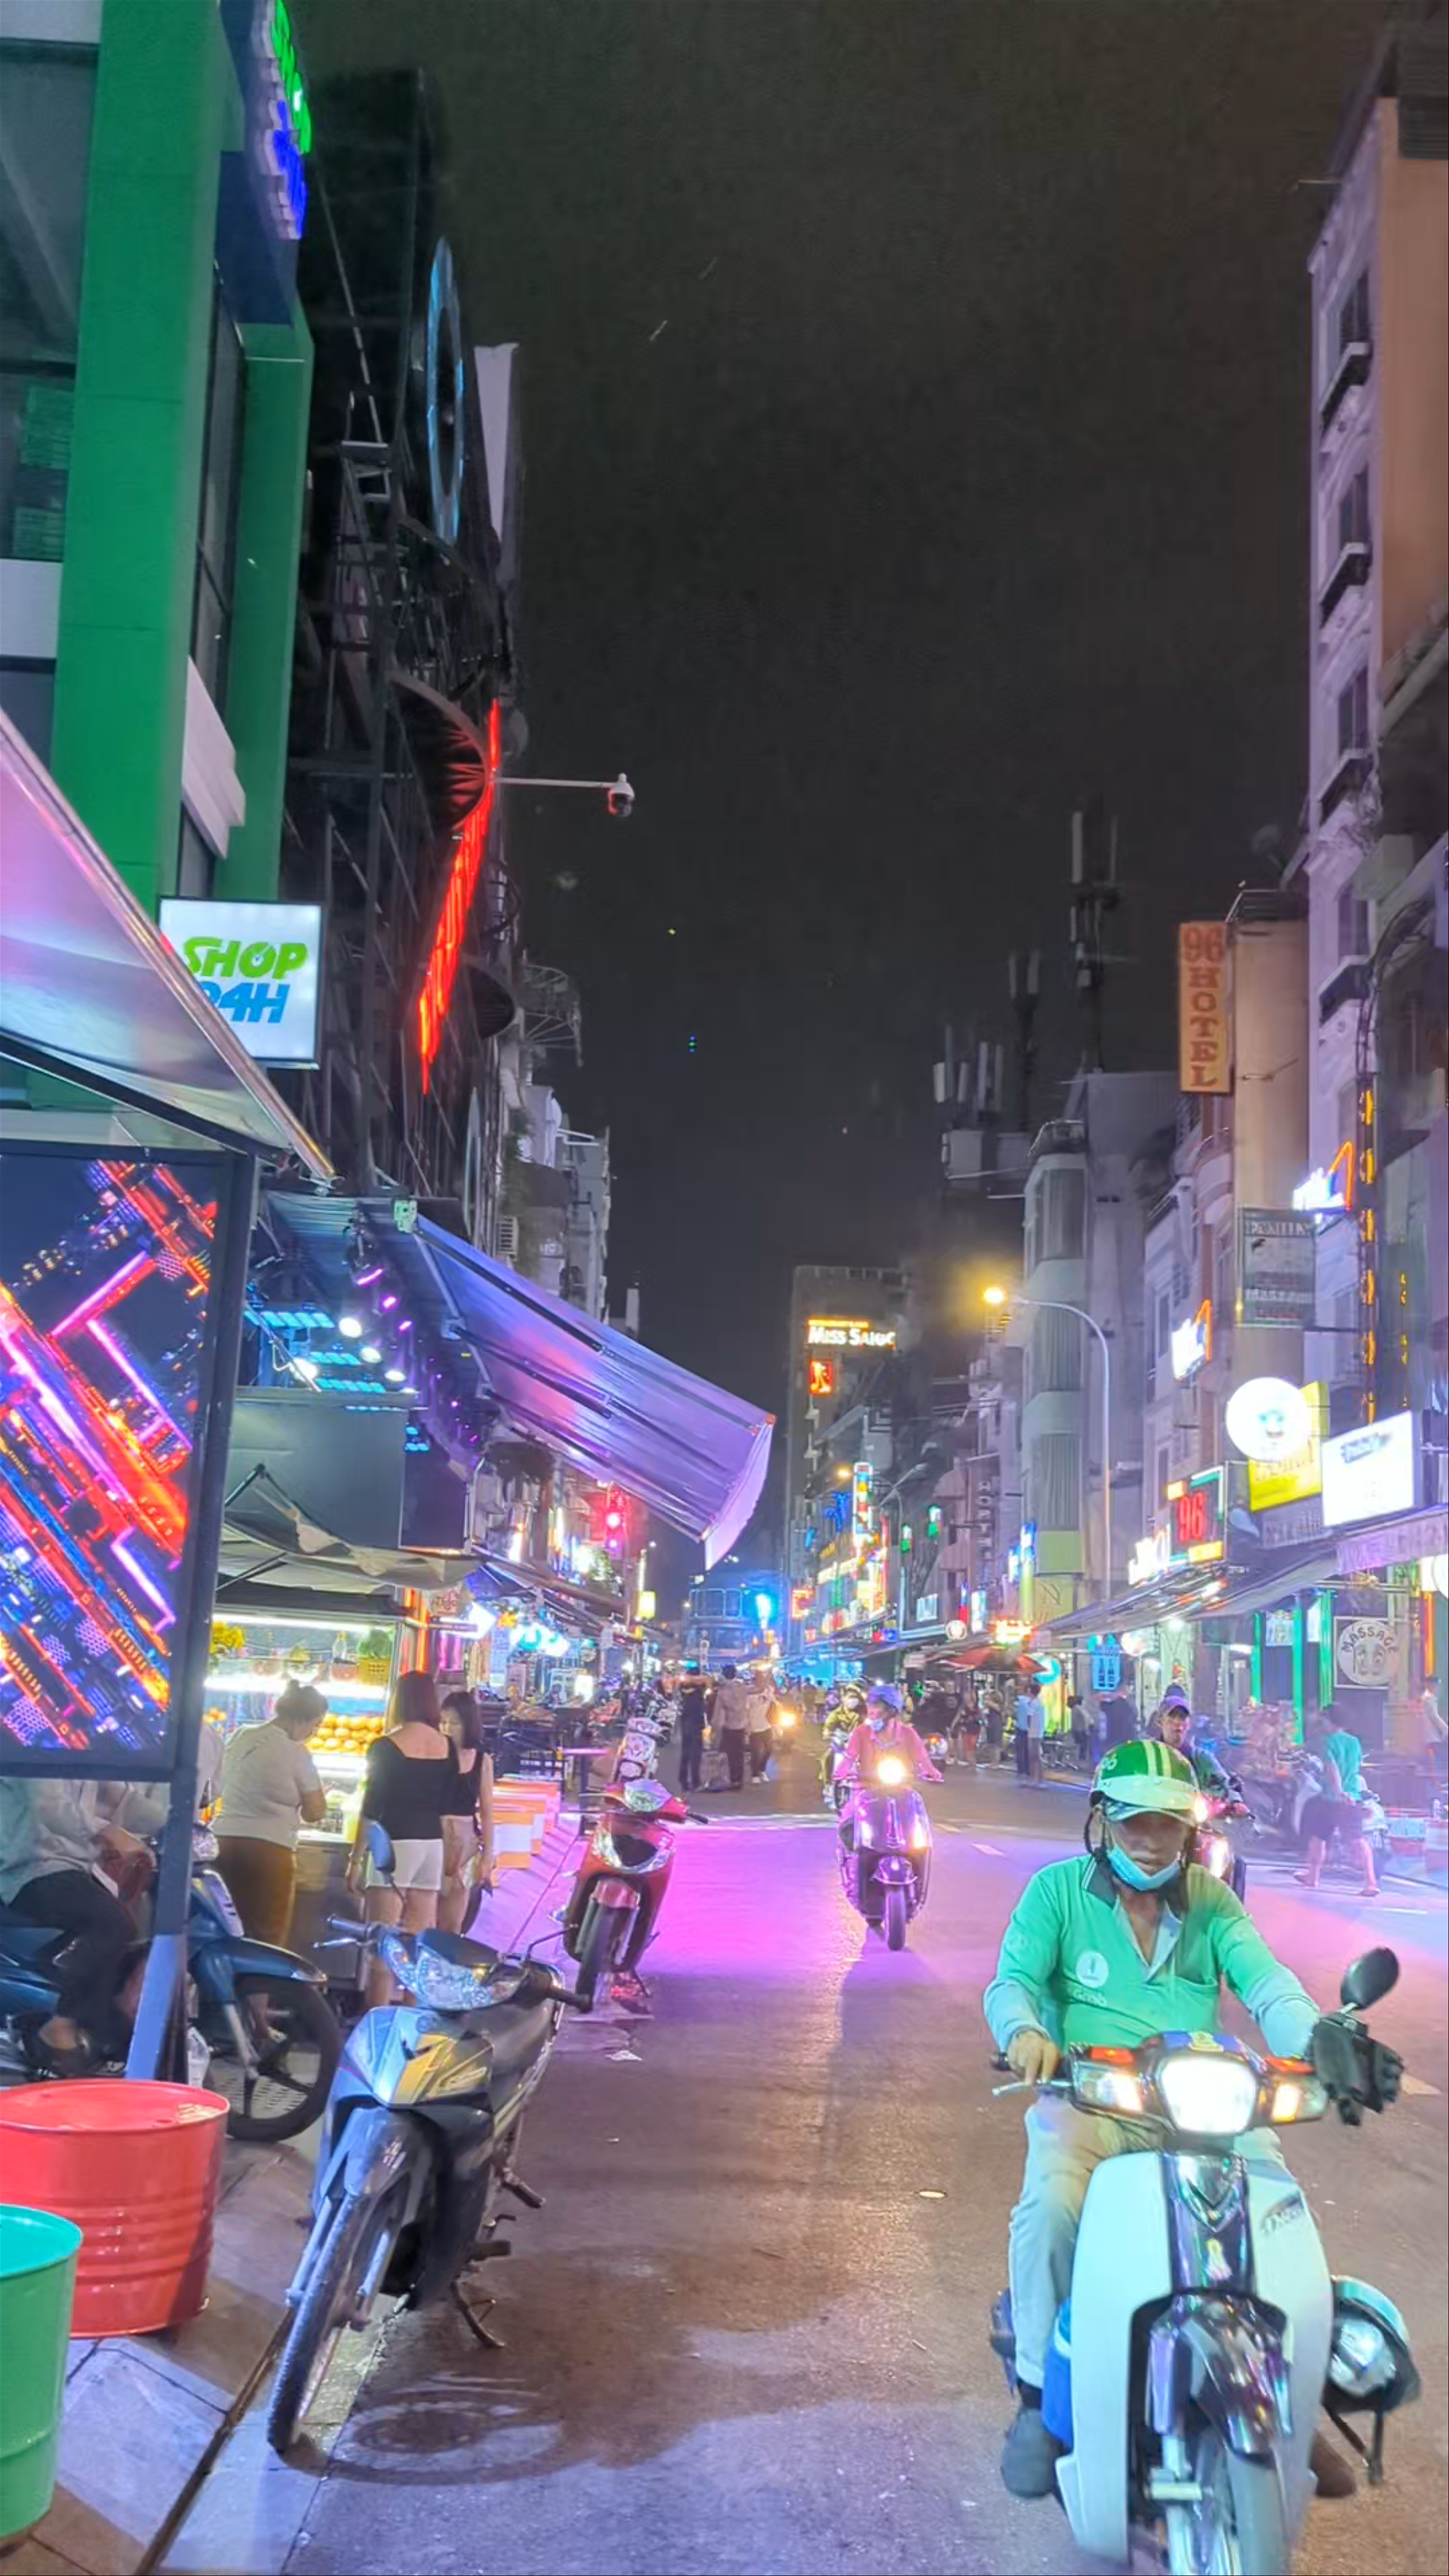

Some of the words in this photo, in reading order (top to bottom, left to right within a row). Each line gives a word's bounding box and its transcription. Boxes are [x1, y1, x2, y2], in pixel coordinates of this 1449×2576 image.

[184, 937, 308, 979] SHOP
[1189, 967, 1219, 1086] HOTEL
[1180, 1490, 1203, 1543] 96
[1341, 1626, 1398, 1653] MASSAGE
